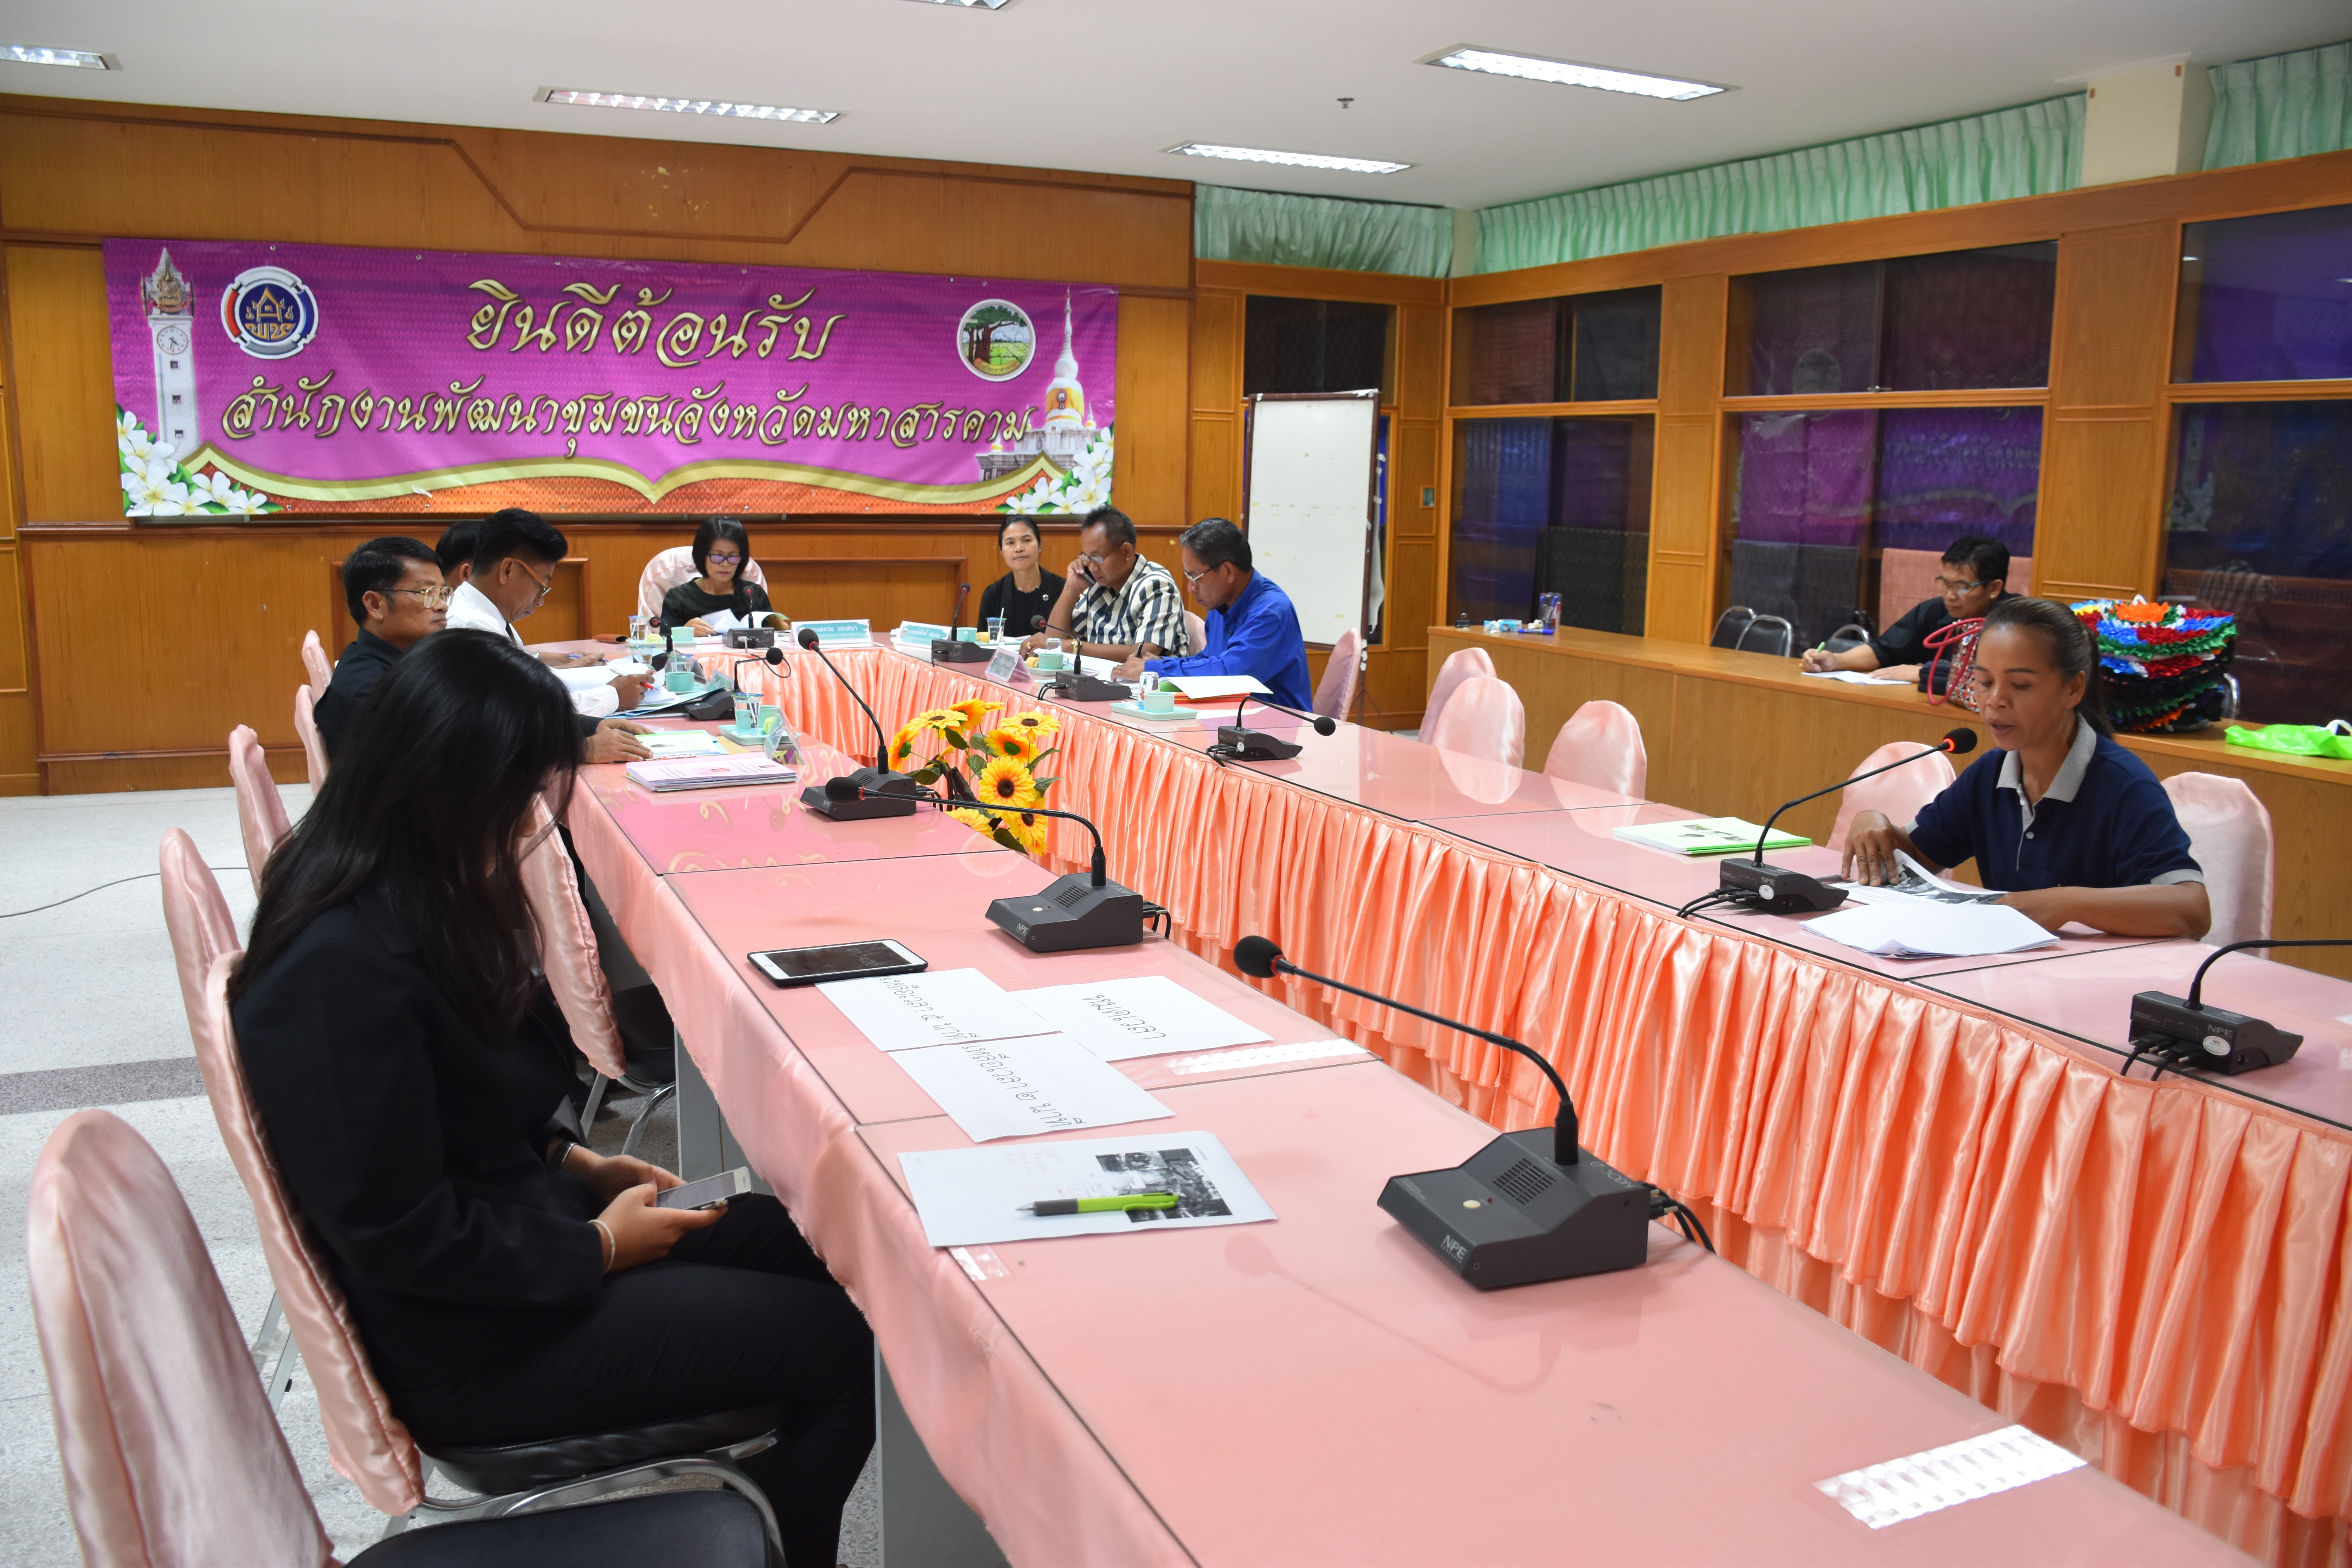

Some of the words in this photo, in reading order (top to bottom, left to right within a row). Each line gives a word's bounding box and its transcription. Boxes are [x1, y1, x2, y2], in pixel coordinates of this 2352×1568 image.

[466, 279, 846, 367] ยินดีต้อนรับ
[222, 370, 1038, 458] สำนักงานพัฒนาชุมชนจังหวัดมหาสารคาม
[1761, 876, 1775, 885] NPE
[1016, 922, 1029, 935] NPE
[879, 977, 933, 1012] เหลือเวลา
[932, 1022, 981, 1040] นาที
[1082, 995, 1166, 1040] หมดเวลา
[2207, 1024, 2233, 1037] NPE
[962, 1045, 1028, 1089] เหลือเวลา
[1029, 1103, 1087, 1127] นาที
[1443, 1234, 1468, 1258] NPE
